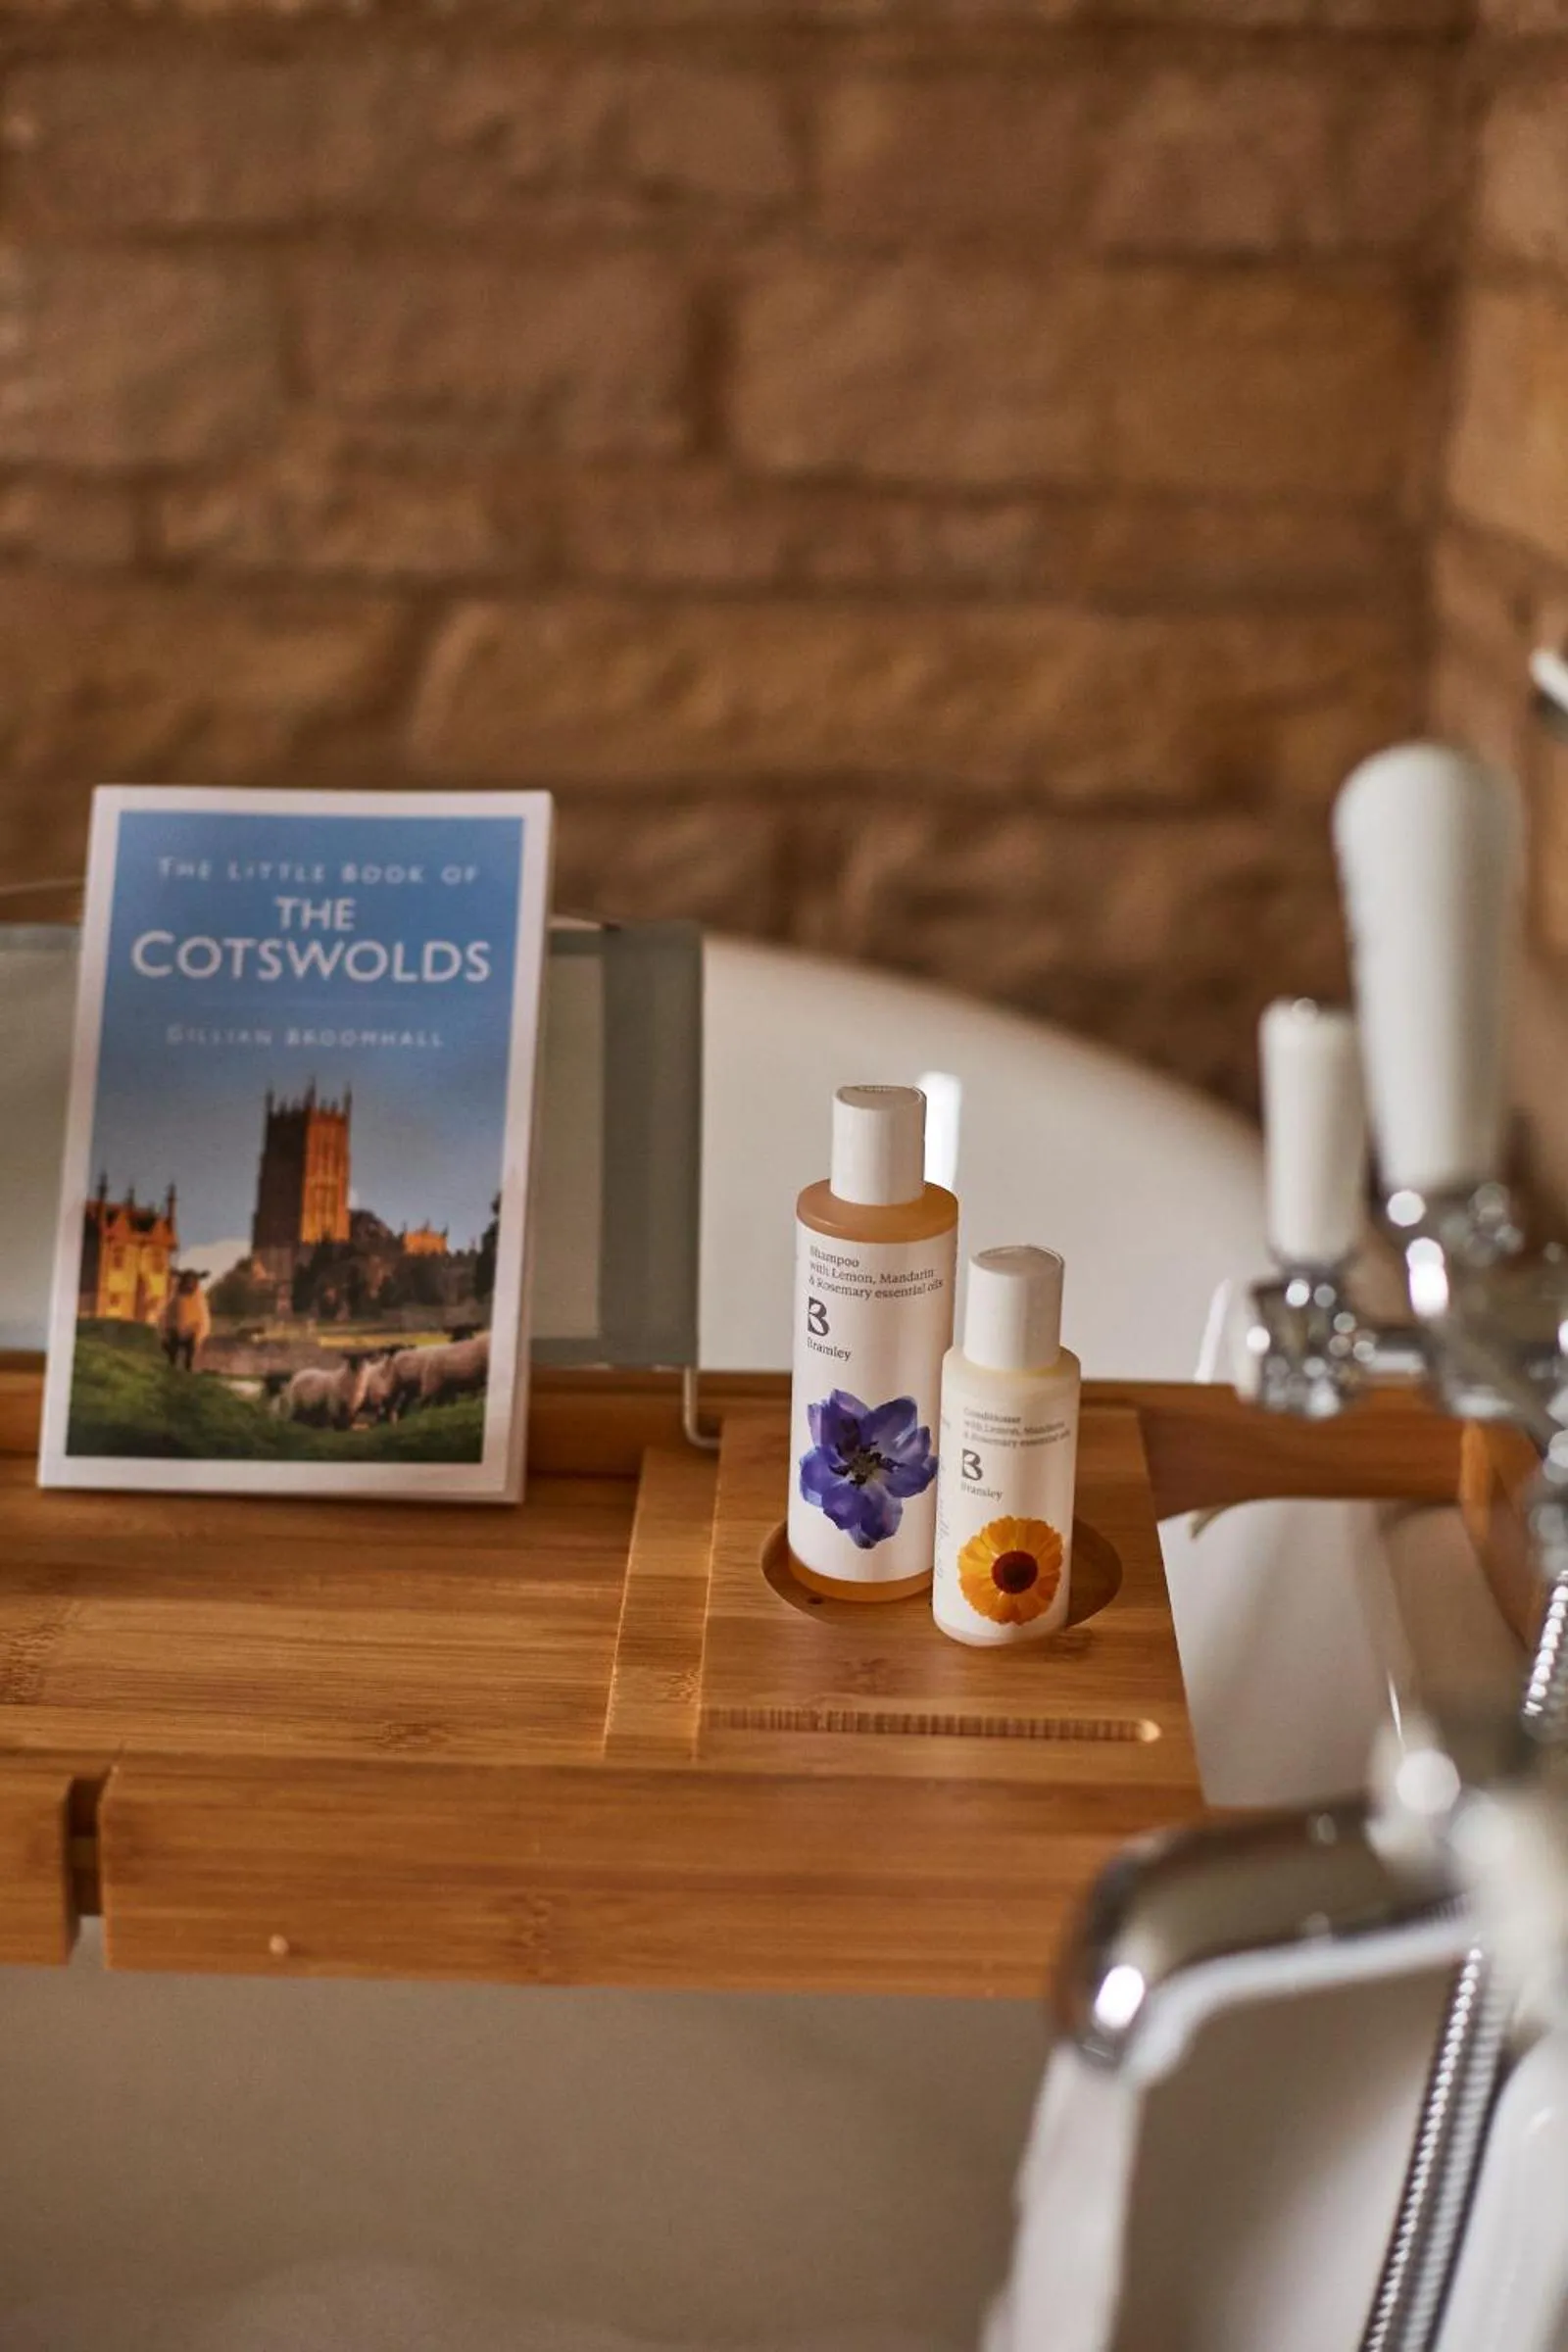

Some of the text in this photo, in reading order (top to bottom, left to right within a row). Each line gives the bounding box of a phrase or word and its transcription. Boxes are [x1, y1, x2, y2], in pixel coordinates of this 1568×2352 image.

[227, 858, 325, 883] LITTLE
[341, 863, 423, 884] BOOK
[441, 864, 477, 885] OF
[274, 896, 356, 931] THE
[131, 930, 491, 983] COTSWOLDS
[809, 1245, 859, 1267] Shampoo
[809, 1261, 934, 1285] with Lemon, Mandarin
[817, 1278, 872, 1300] Rosemary
[874, 1283, 926, 1298] essential
[927, 1278, 944, 1292] oils
[808, 1296, 830, 1338] B
[808, 1337, 852, 1361] Bramley
[961, 1447, 984, 1482] B
